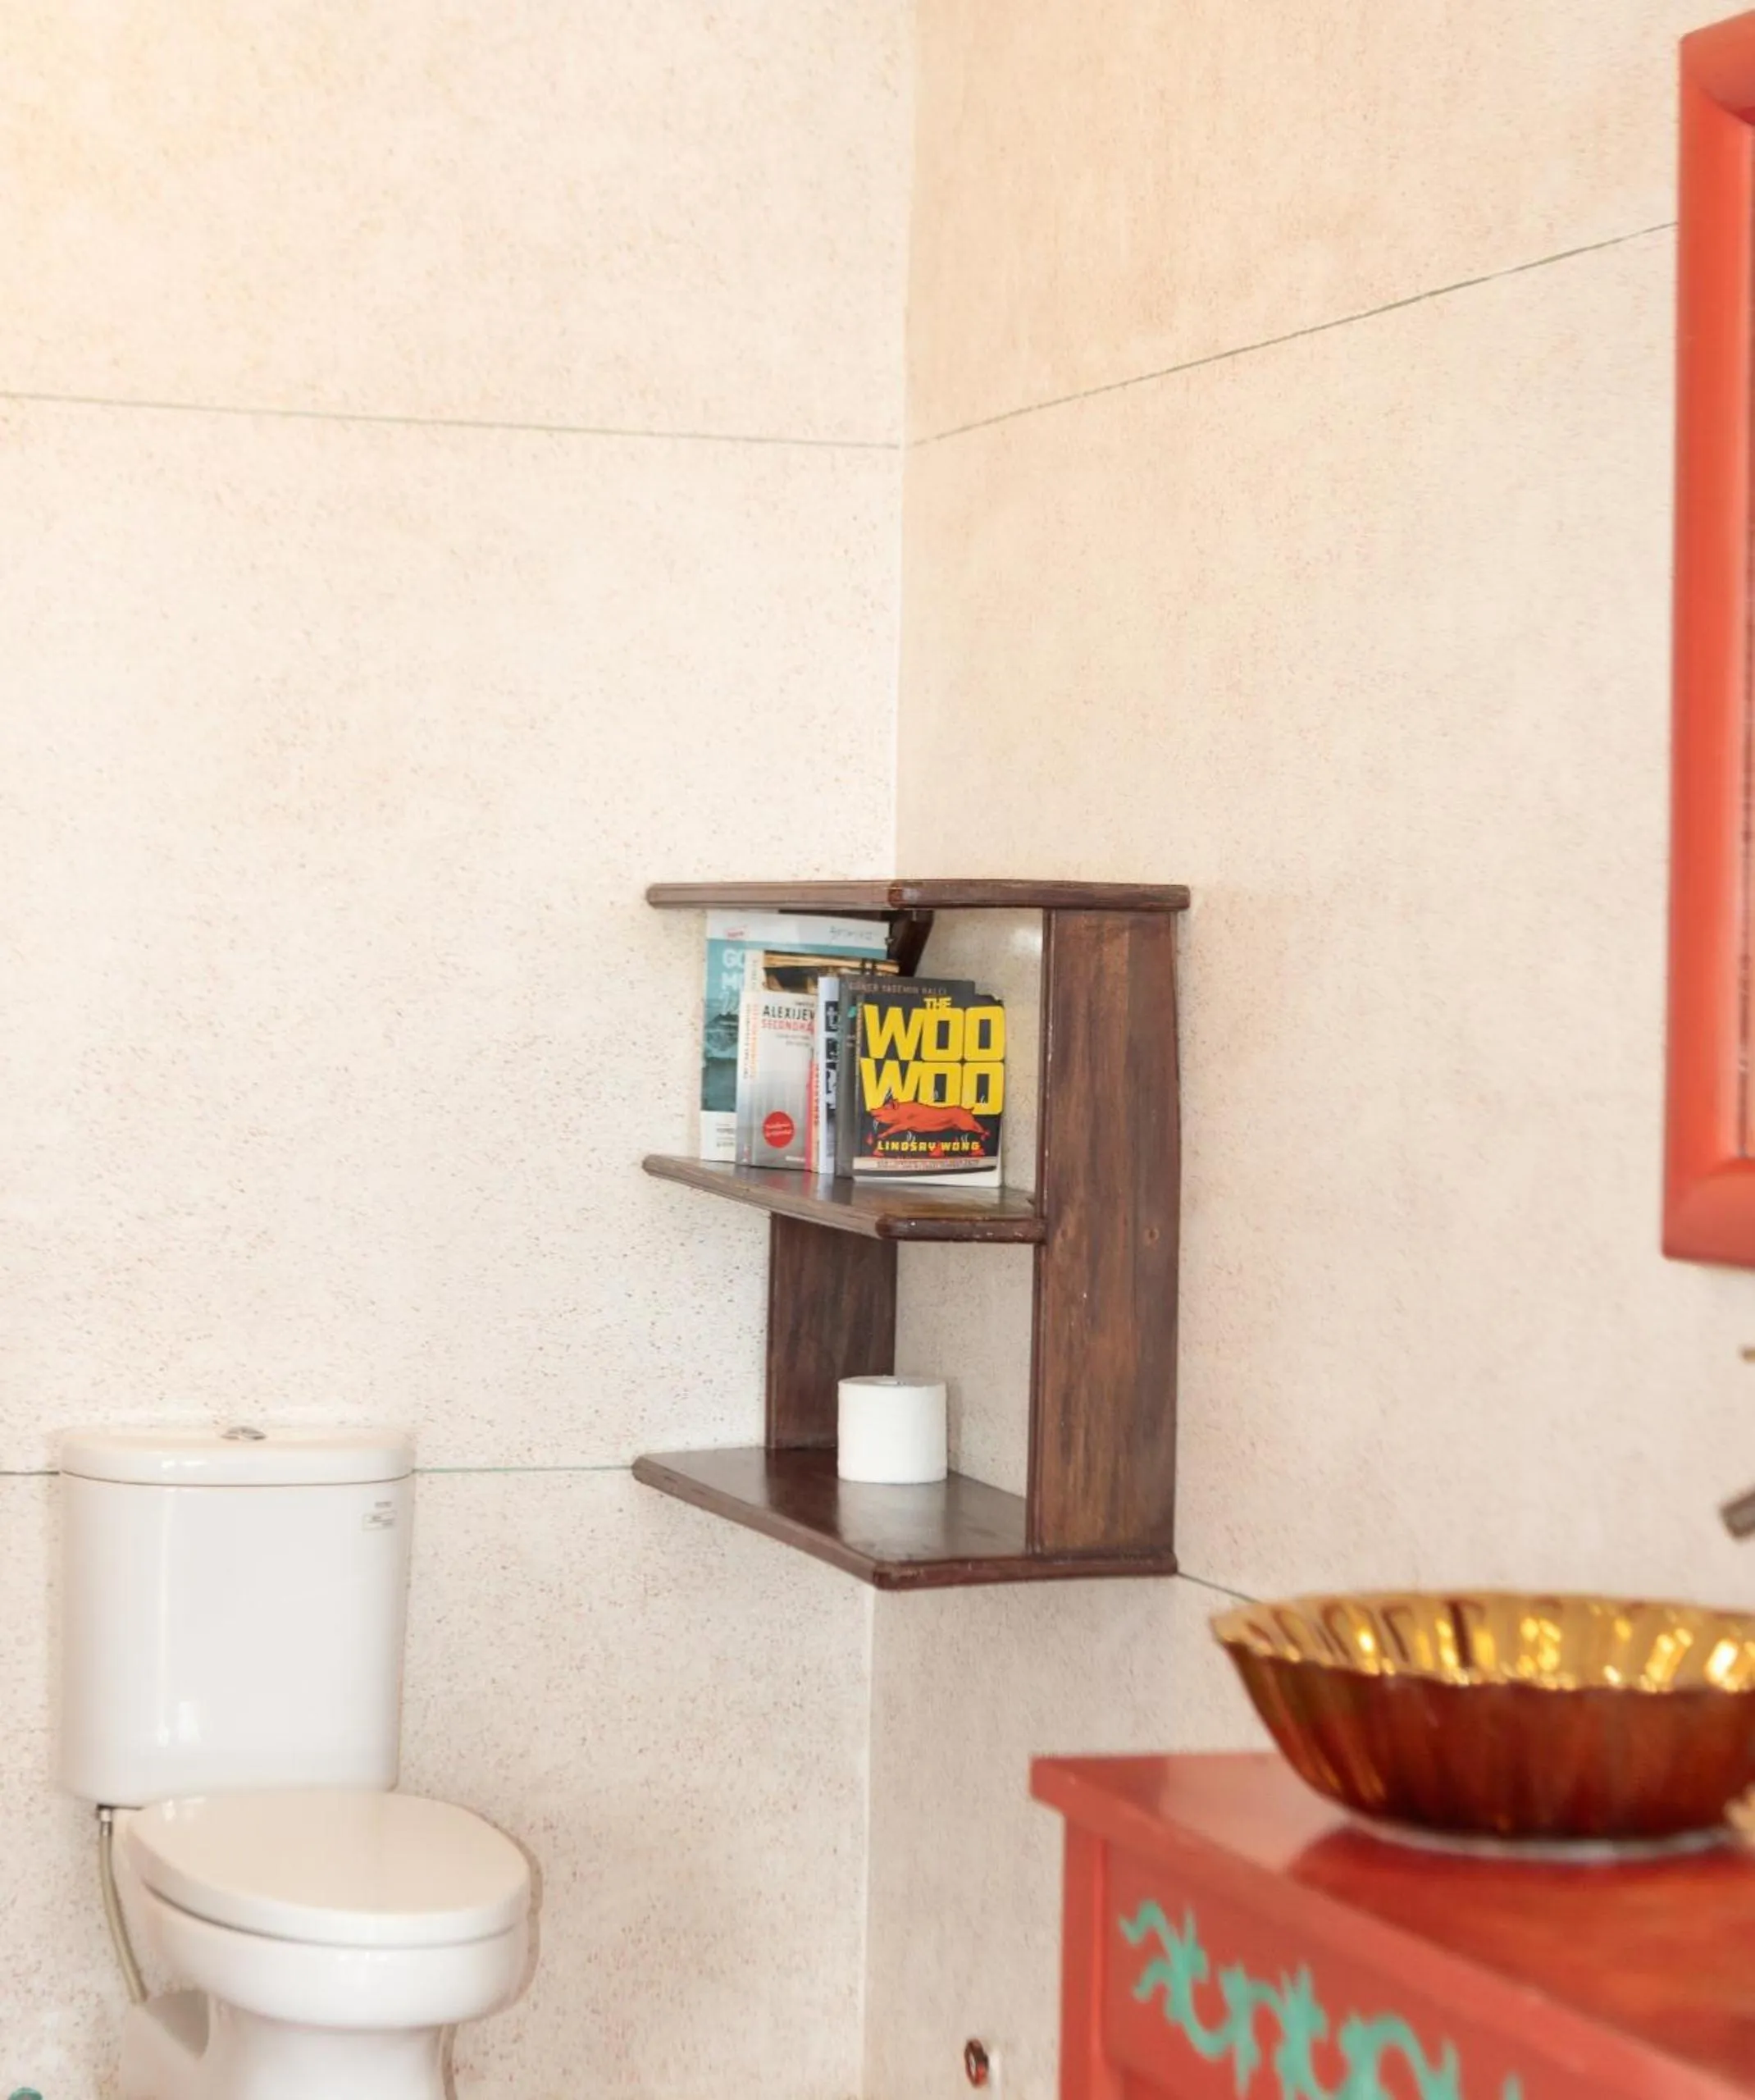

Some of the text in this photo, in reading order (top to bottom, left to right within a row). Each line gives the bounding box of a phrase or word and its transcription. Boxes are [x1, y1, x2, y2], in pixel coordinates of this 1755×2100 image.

[923, 996, 951, 1010] THE
[864, 1003, 1005, 1061] WOO
[860, 1057, 1005, 1115] WOO
[877, 1140, 982, 1153] LINDSAY WONG
